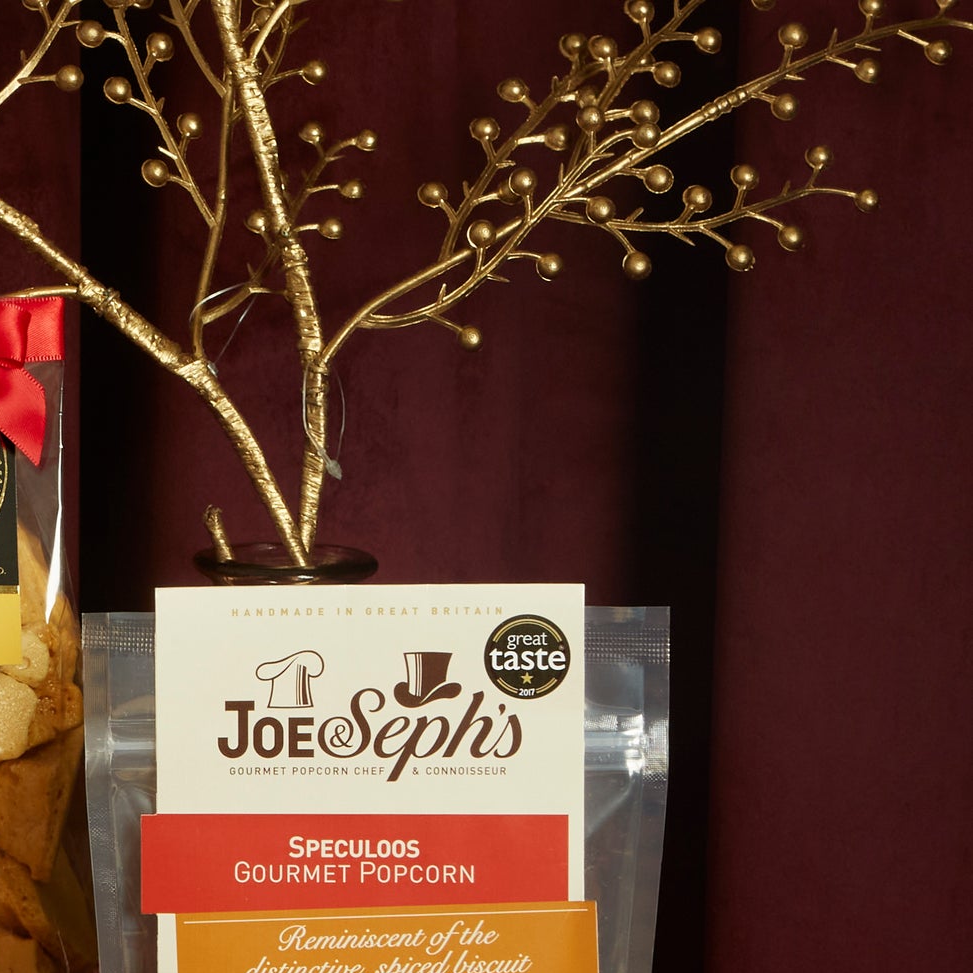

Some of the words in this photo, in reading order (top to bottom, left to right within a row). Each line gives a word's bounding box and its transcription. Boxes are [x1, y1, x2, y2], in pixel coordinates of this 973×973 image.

[231, 608, 324, 617] HANDMADE
[336, 607, 353, 616] IN
[365, 607, 418, 616] GREAT
[431, 606, 503, 616] BRITAIN
[506, 632, 547, 649] great
[489, 648, 566, 671] taste
[518, 688, 535, 697] 2017
[218, 700, 314, 758] JOE
[229, 767, 287, 776] GOURMET
[292, 767, 348, 776] POPCORN
[354, 767, 385, 775] CHEF
[413, 767, 419, 775] &
[425, 767, 507, 776] CONNOISSEUR
[288, 836, 420, 859] SPECULOOS
[234, 861, 350, 884] GOURMET
[360, 861, 475, 884] POPCORN
[278, 925, 425, 952] Reminiscent
[425, 921, 464, 955] of
[459, 920, 499, 946] the
